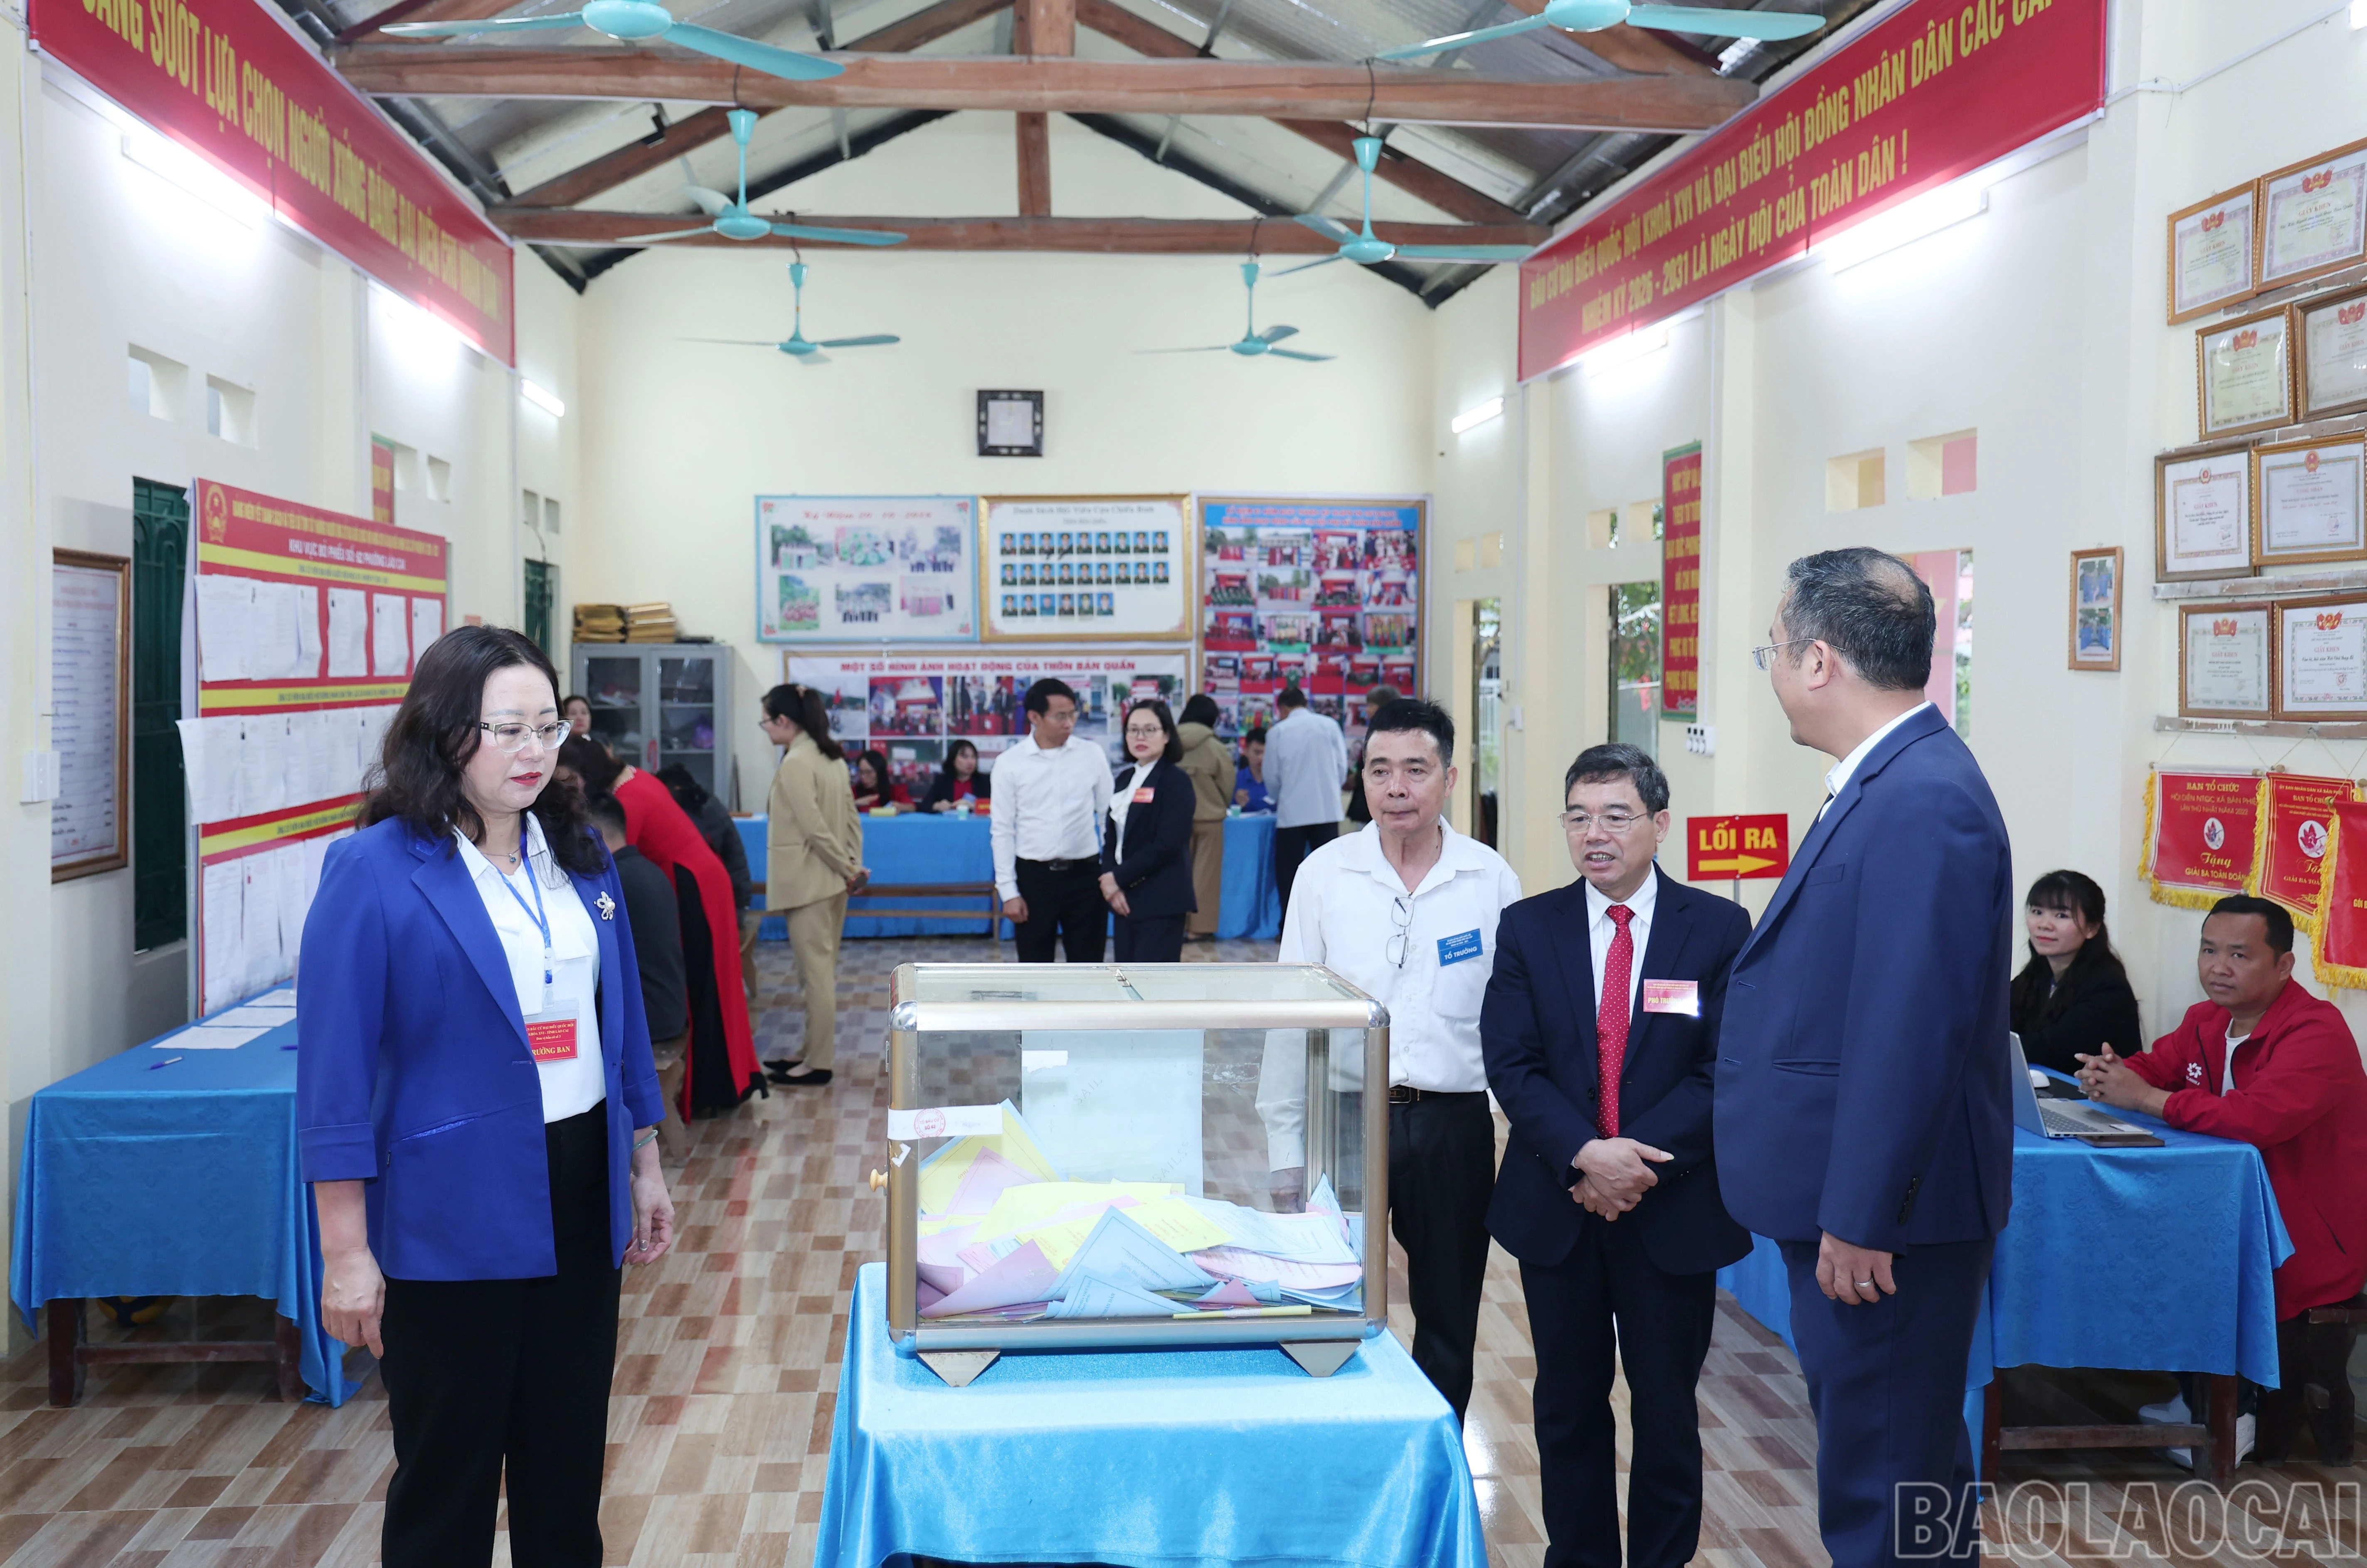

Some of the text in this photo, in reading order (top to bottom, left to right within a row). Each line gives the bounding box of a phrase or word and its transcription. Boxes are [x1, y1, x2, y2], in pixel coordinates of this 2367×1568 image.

[205, 26, 239, 133] LỰA
[242, 59, 285, 169] CHỌN
[1674, 190, 1693, 228] XVI
[1694, 165, 1712, 215] VÀ
[1714, 156, 1737, 207] ĐẠI
[1739, 123, 1771, 190] BIỂU
[1775, 111, 1800, 171] HỘI
[1804, 84, 1849, 151] ĐỒNG
[1854, 49, 1906, 122] NHÂN
[1911, 17, 1953, 89] DÂN
[1663, 251, 1689, 296] 2031
[1693, 233, 1706, 281] LÀ
[1711, 216, 1745, 271] NGÀY
[1748, 198, 1772, 256] HỘI
[1776, 174, 1806, 233] CỦA
[1810, 158, 1853, 221] TOÀN
[1858, 135, 1895, 197] DÂN
[1901, 128, 1908, 175] !
[841, 662, 865, 672] MỘT
[869, 659, 885, 671] SỐ
[888, 660, 917, 671] HÌNH
[919, 659, 944, 671] ẢNH
[980, 660, 1013, 672] ĐỘNG
[1016, 659, 1039, 670] CỦA
[1043, 660, 1073, 671] THÔN
[2187, 779, 2240, 793] BAN TỔ CHỨC
[2306, 793, 2313, 802] TỔ
[1699, 820, 1778, 851] LỐI RA
[2201, 852, 2231, 869] Tặng
[2185, 866, 2200, 876] GIẢI
[2210, 869, 2228, 879] TOÀN
[2283, 874, 2298, 882] GIẢI
[1444, 946, 1477, 960] TỔ TRƯỞNG
[532, 1045, 570, 1056] RƯỞNG BAN
